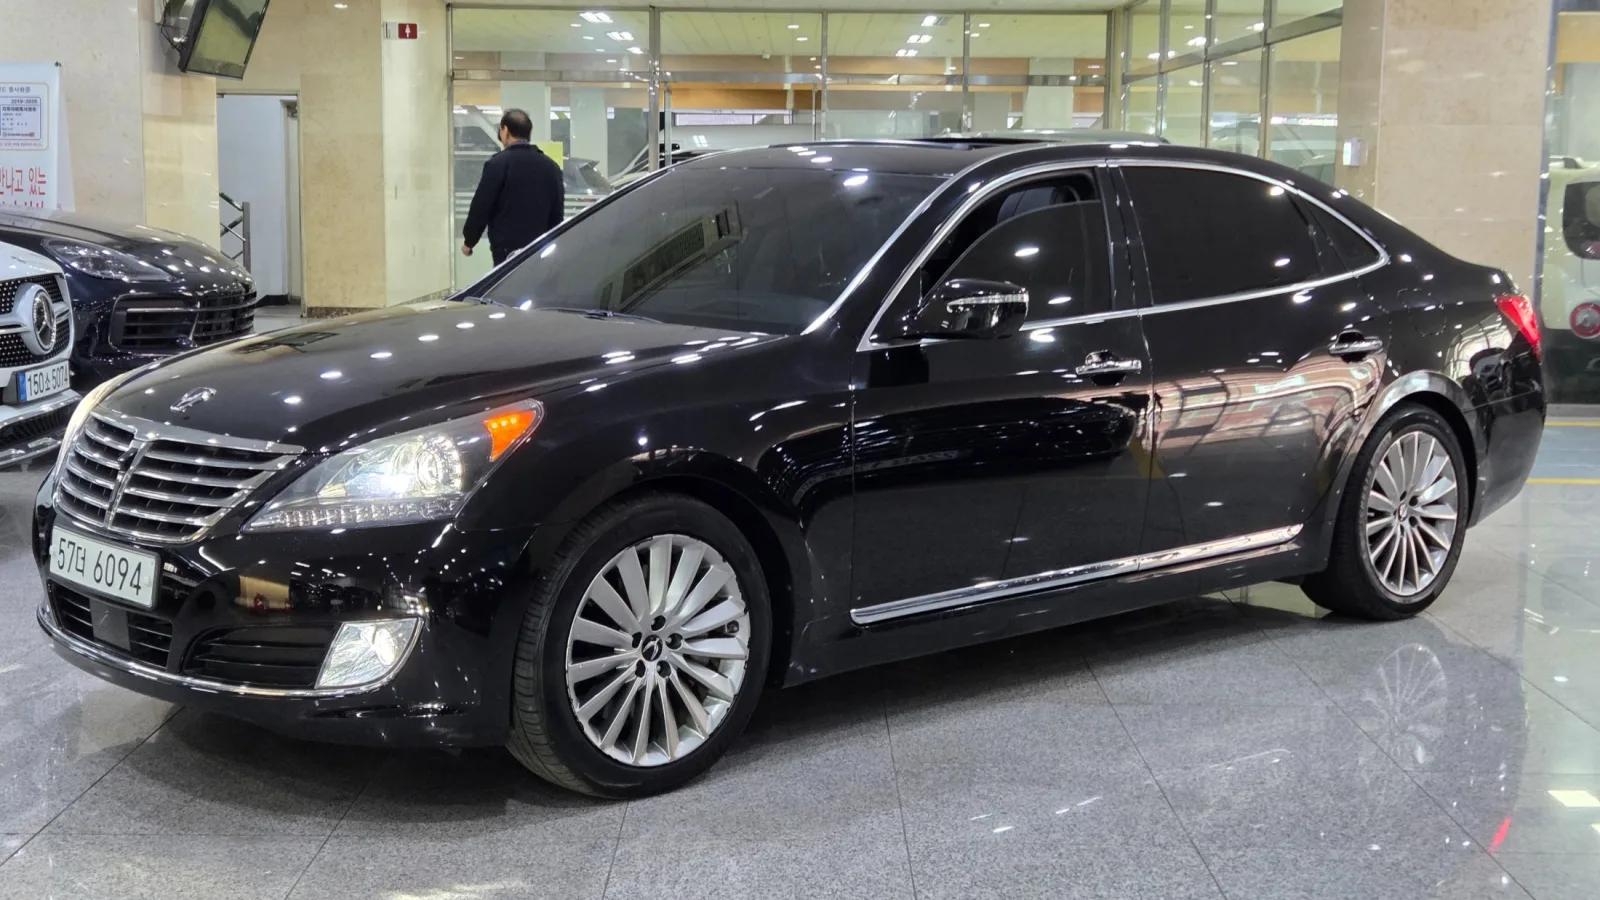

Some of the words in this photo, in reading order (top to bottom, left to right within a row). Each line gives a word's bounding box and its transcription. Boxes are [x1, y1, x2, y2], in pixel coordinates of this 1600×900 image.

[29, 166, 46, 195] 있는
[28, 371, 51, 396] 150소
[57, 537, 87, 577] 57더
[93, 550, 142, 596] 6094
